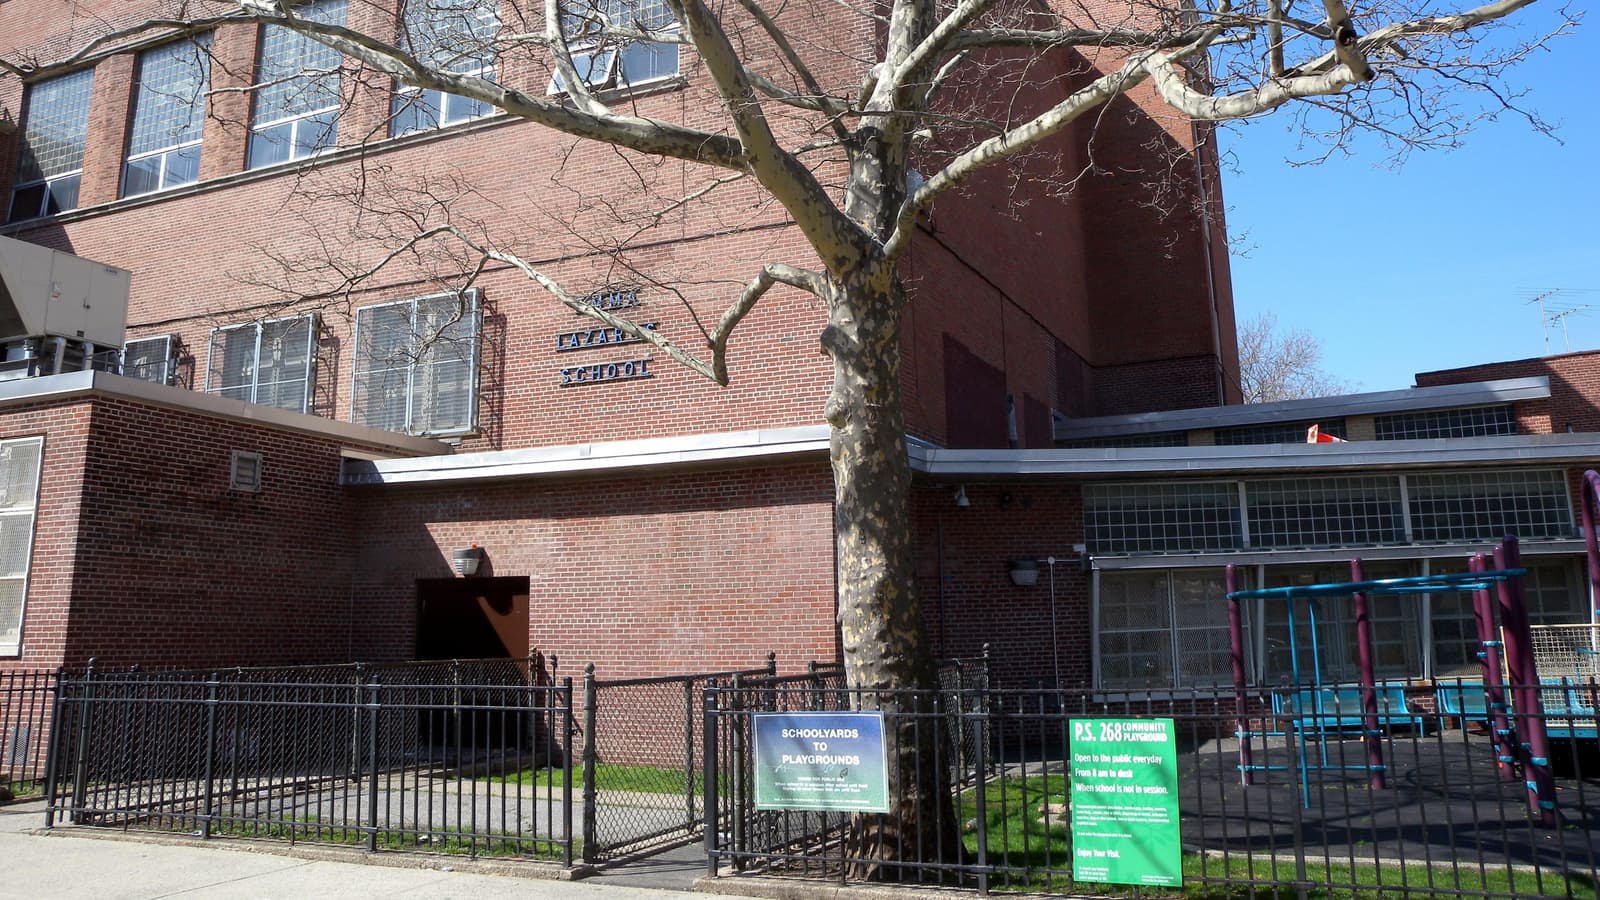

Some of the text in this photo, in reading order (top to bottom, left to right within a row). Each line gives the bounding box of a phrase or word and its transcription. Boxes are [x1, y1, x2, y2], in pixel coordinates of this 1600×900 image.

[577, 291, 637, 308] MMA
[561, 360, 650, 384] SCHOOL
[1074, 722, 1122, 742] P.S. 268
[1122, 722, 1166, 732] COMMUNITY
[781, 728, 859, 738] SCHOOLYARDS
[1123, 732, 1168, 742] PLAYGROUND
[812, 742, 828, 751] TO
[782, 754, 860, 765] PLAYGROUNDS
[1074, 753, 1162, 765] Open to the public everyday
[1075, 768, 1091, 777] From
[1097, 770, 1108, 778] am
[1109, 769, 1116, 778] to
[1117, 769, 1133, 778] dusk
[1075, 783, 1168, 794] When school is not in session.
[1077, 847, 1092, 858] Enjoy
[1093, 849, 1105, 858] Your
